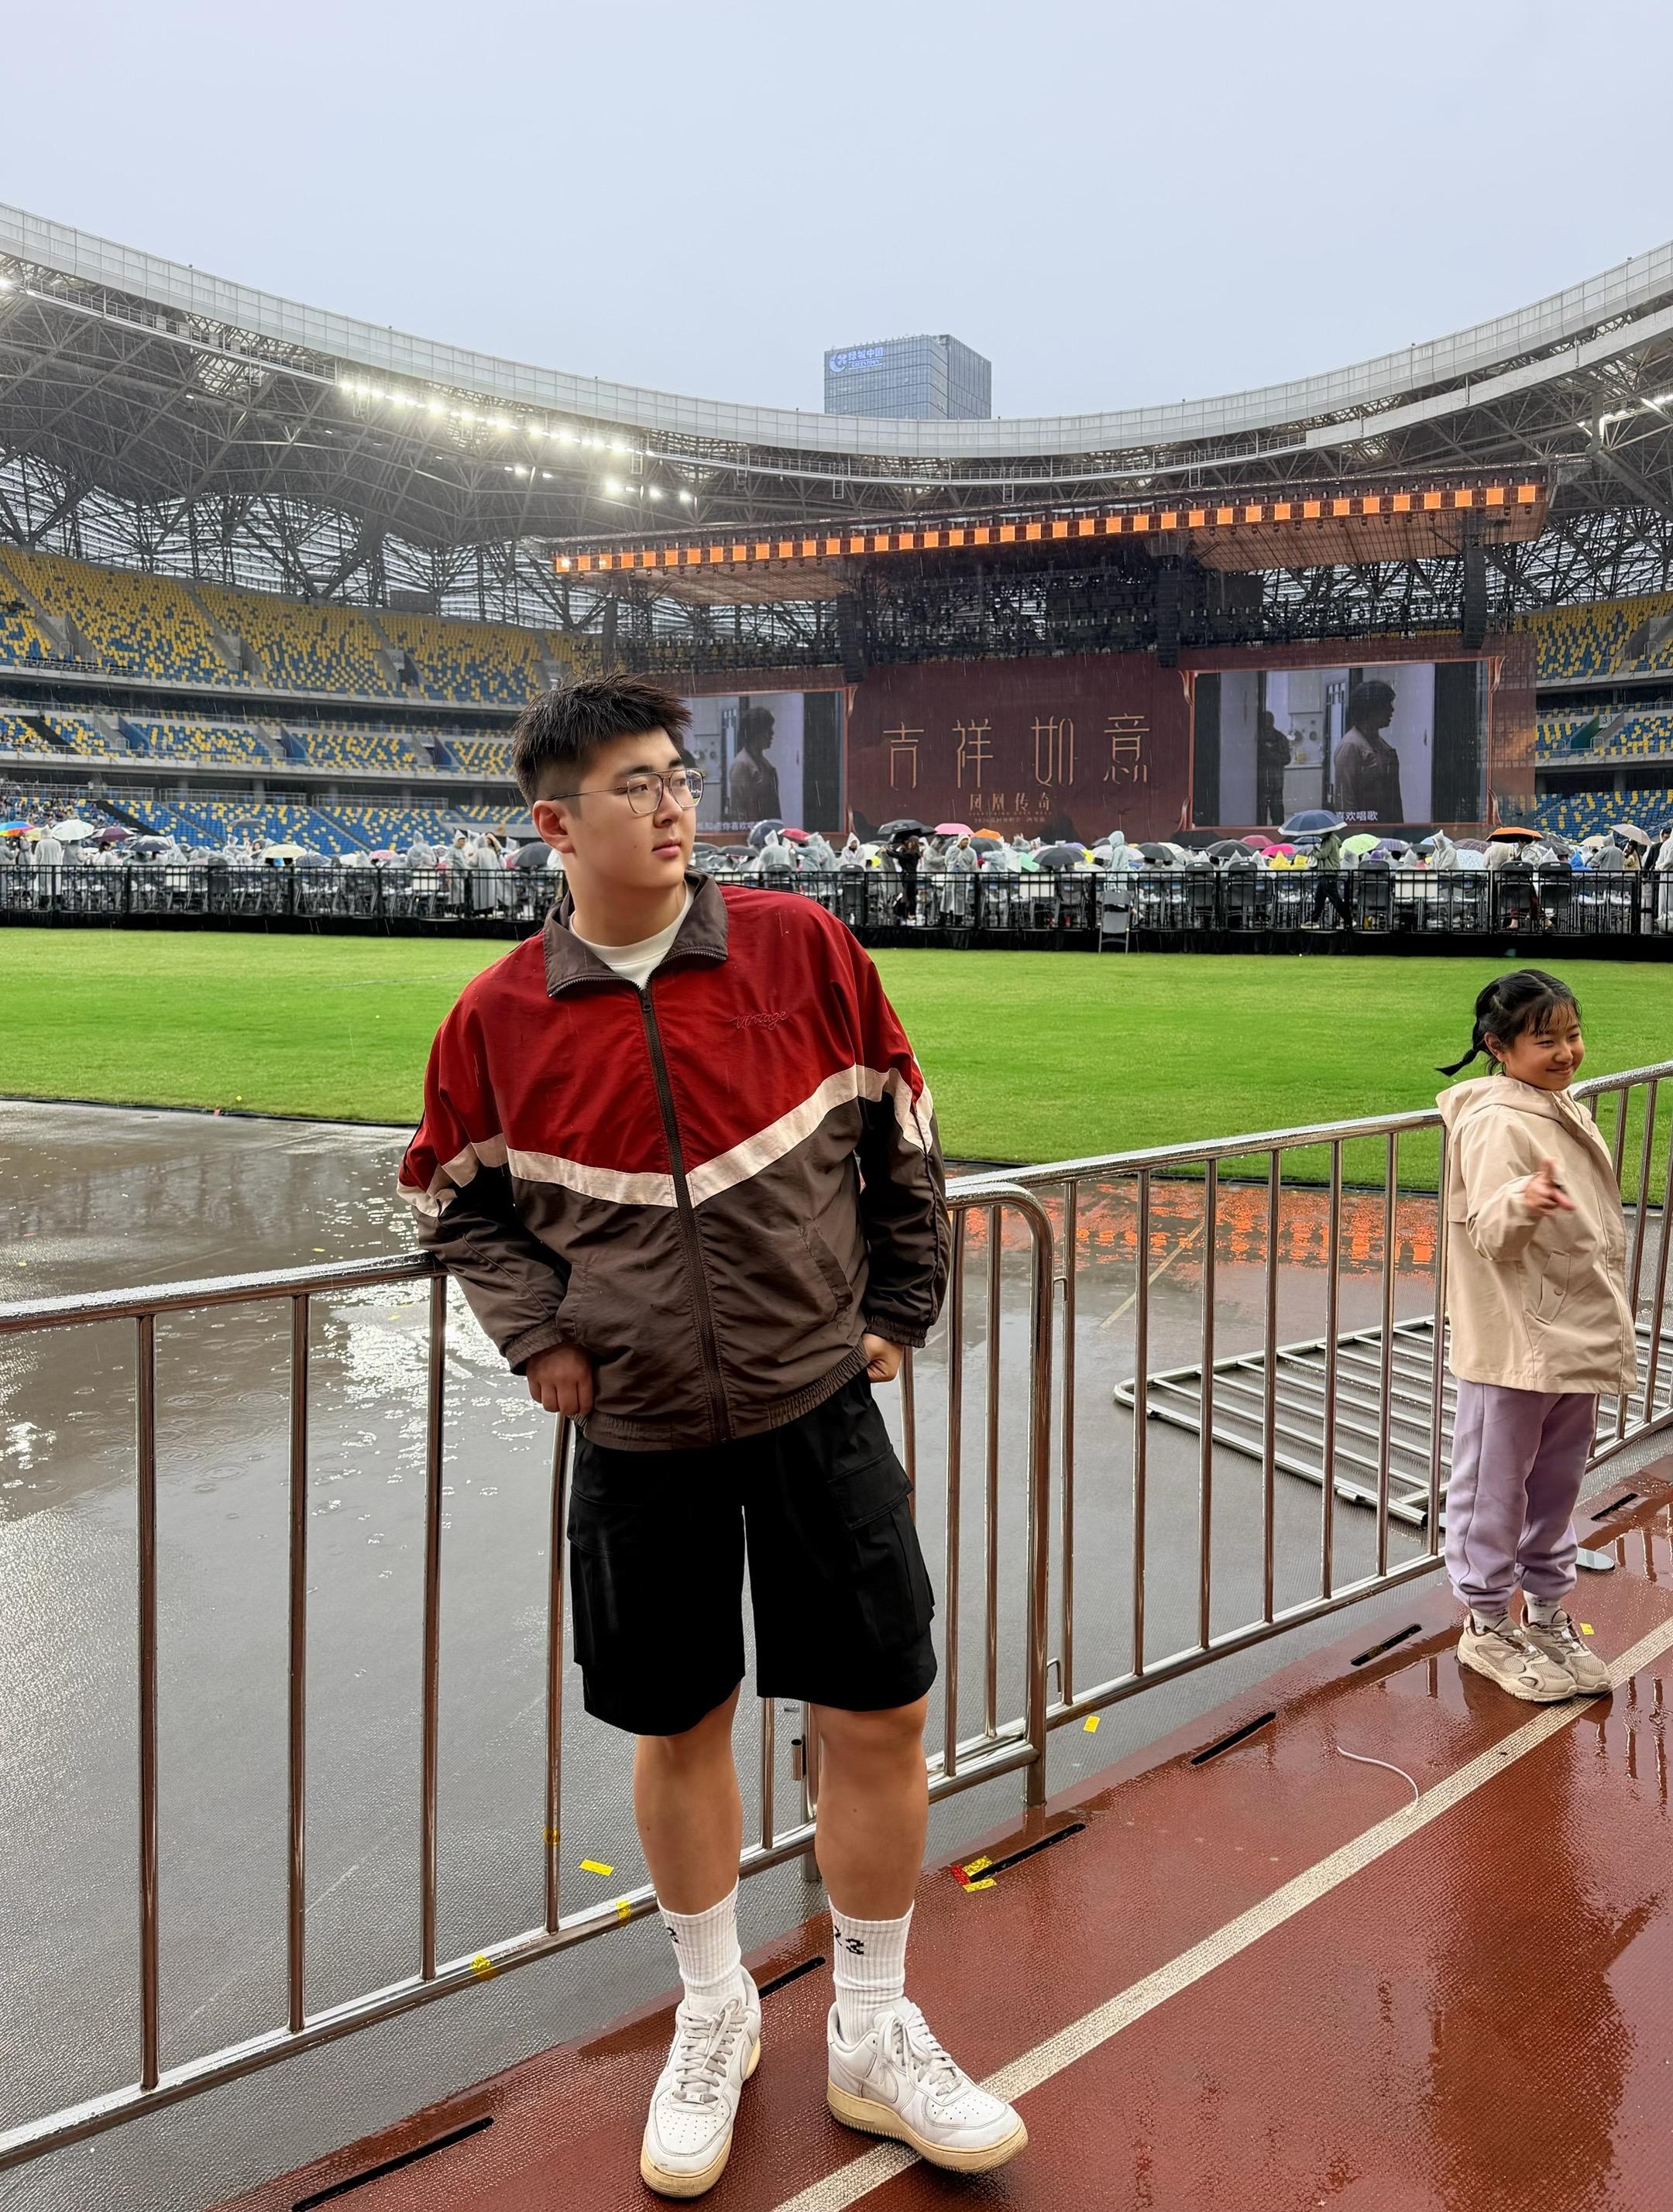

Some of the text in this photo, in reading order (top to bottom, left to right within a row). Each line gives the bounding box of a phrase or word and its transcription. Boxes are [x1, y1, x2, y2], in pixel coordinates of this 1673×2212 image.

[848, 346, 884, 361] 绿城中国
[883, 713, 1150, 791] 吉祥如意
[969, 792, 1051, 812] 凤凰传奇
